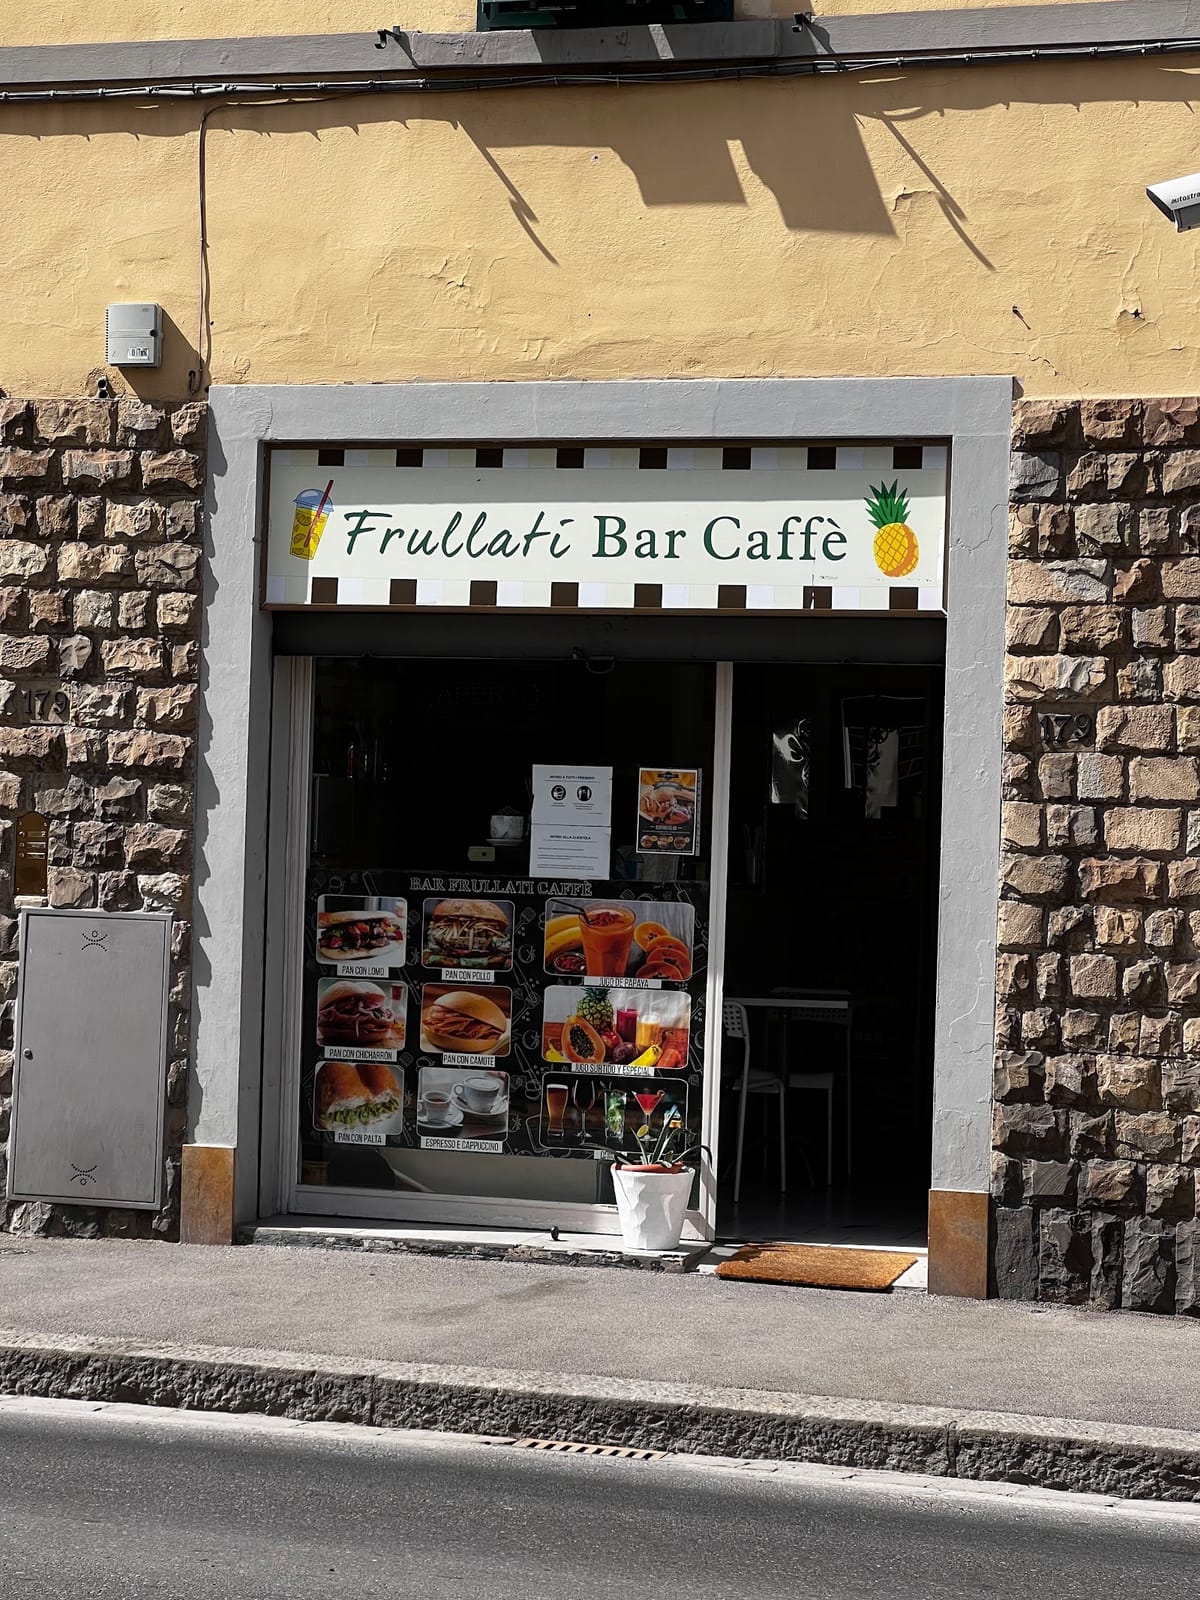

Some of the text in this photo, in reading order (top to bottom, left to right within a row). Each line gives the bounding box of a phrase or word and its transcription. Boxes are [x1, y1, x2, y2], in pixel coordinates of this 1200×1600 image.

[343, 509, 848, 561] Frullati Bar Caffè
[21, 690, 68, 715] 179
[1038, 712, 1092, 742] 179
[410, 877, 593, 896] BAR FRULLATI CAFFÈ
[341, 965, 385, 976] PAN CON LOMO
[445, 969, 491, 981] PAN CON POLLO
[624, 978, 649, 989] PAPAYA
[329, 1048, 342, 1058] PAN
[343, 1049, 355, 1059] CON
[444, 1054, 495, 1066] PAN CON CAMOTE
[338, 1132, 382, 1144] PAN CON PALTA
[425, 1138, 499, 1152] ESPRESSO E CAPPUCCINO
